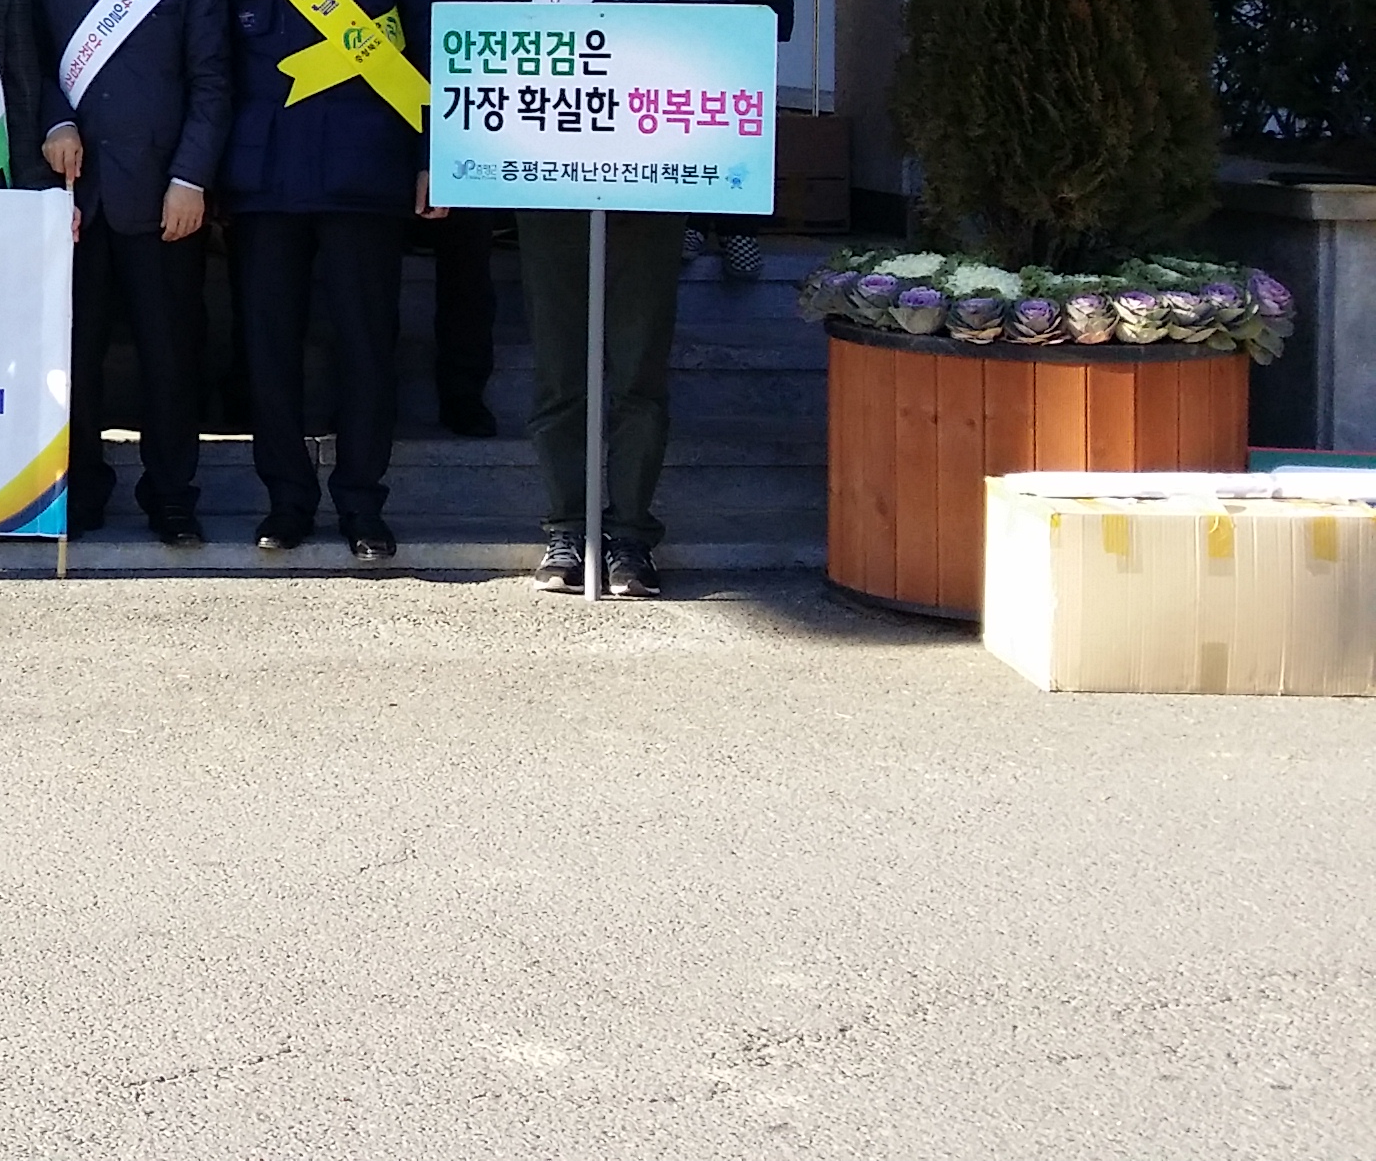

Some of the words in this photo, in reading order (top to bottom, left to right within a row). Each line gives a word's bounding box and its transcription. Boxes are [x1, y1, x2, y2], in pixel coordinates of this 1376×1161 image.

[443, 30, 612, 76] 안전점검은
[443, 87, 509, 132] 가장
[517, 86, 620, 133] 확실한
[627, 88, 764, 137] 행복보험
[501, 160, 720, 186] 증평군재난안전대책본부
